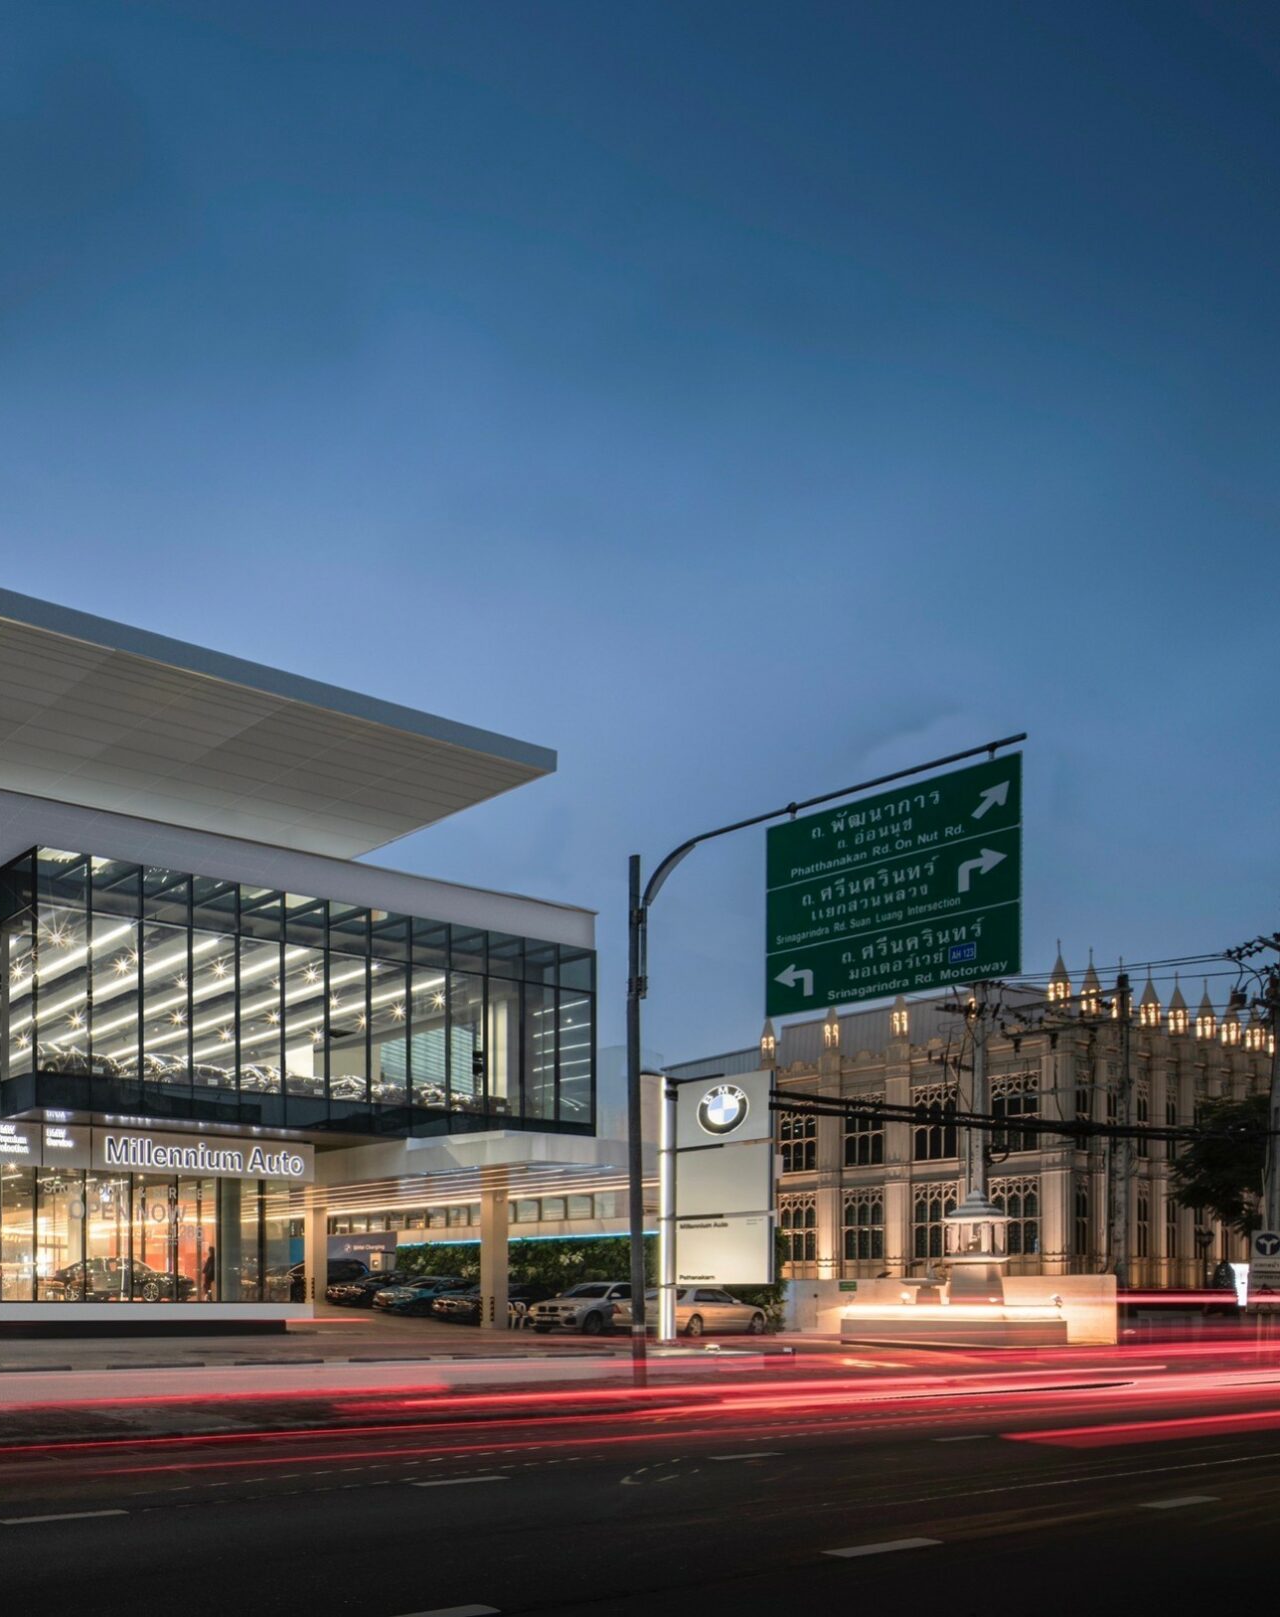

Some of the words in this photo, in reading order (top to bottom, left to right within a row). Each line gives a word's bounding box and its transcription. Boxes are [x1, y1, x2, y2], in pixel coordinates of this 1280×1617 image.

[812, 827, 825, 839] ถ.
[831, 790, 940, 833] พัฒนาการ
[854, 818, 913, 845] อ่อนนุช
[790, 851, 867, 878] Phatthanakan
[895, 838, 912, 850] On
[918, 831, 938, 844] Nut
[945, 824, 965, 837] Rd.
[801, 894, 815, 906] ถ.
[821, 855, 940, 901] ศรีนครินทร์
[776, 925, 830, 945] Srinagarindra
[833, 921, 847, 932] Rd.
[849, 917, 871, 929] Suan
[876, 909, 903, 923] Luang
[907, 897, 961, 916] Intersection
[812, 884, 929, 921] แยกสวนหลวง
[841, 952, 855, 964] ถ.
[862, 917, 985, 960] ศรีนครินทร์
[951, 949, 961, 960] AH
[827, 979, 909, 1000] Srinagarindra
[915, 973, 934, 984] Rd.
[940, 960, 1008, 980] Motorway
[848, 947, 946, 980] มอเตอร์เวย์
[702, 1086, 745, 1104] BMW
[105, 1135, 243, 1172] Millennium
[247, 1146, 305, 1176] Auto
[68, 1200, 130, 1221] OPEN
[136, 1204, 187, 1223] NOW
